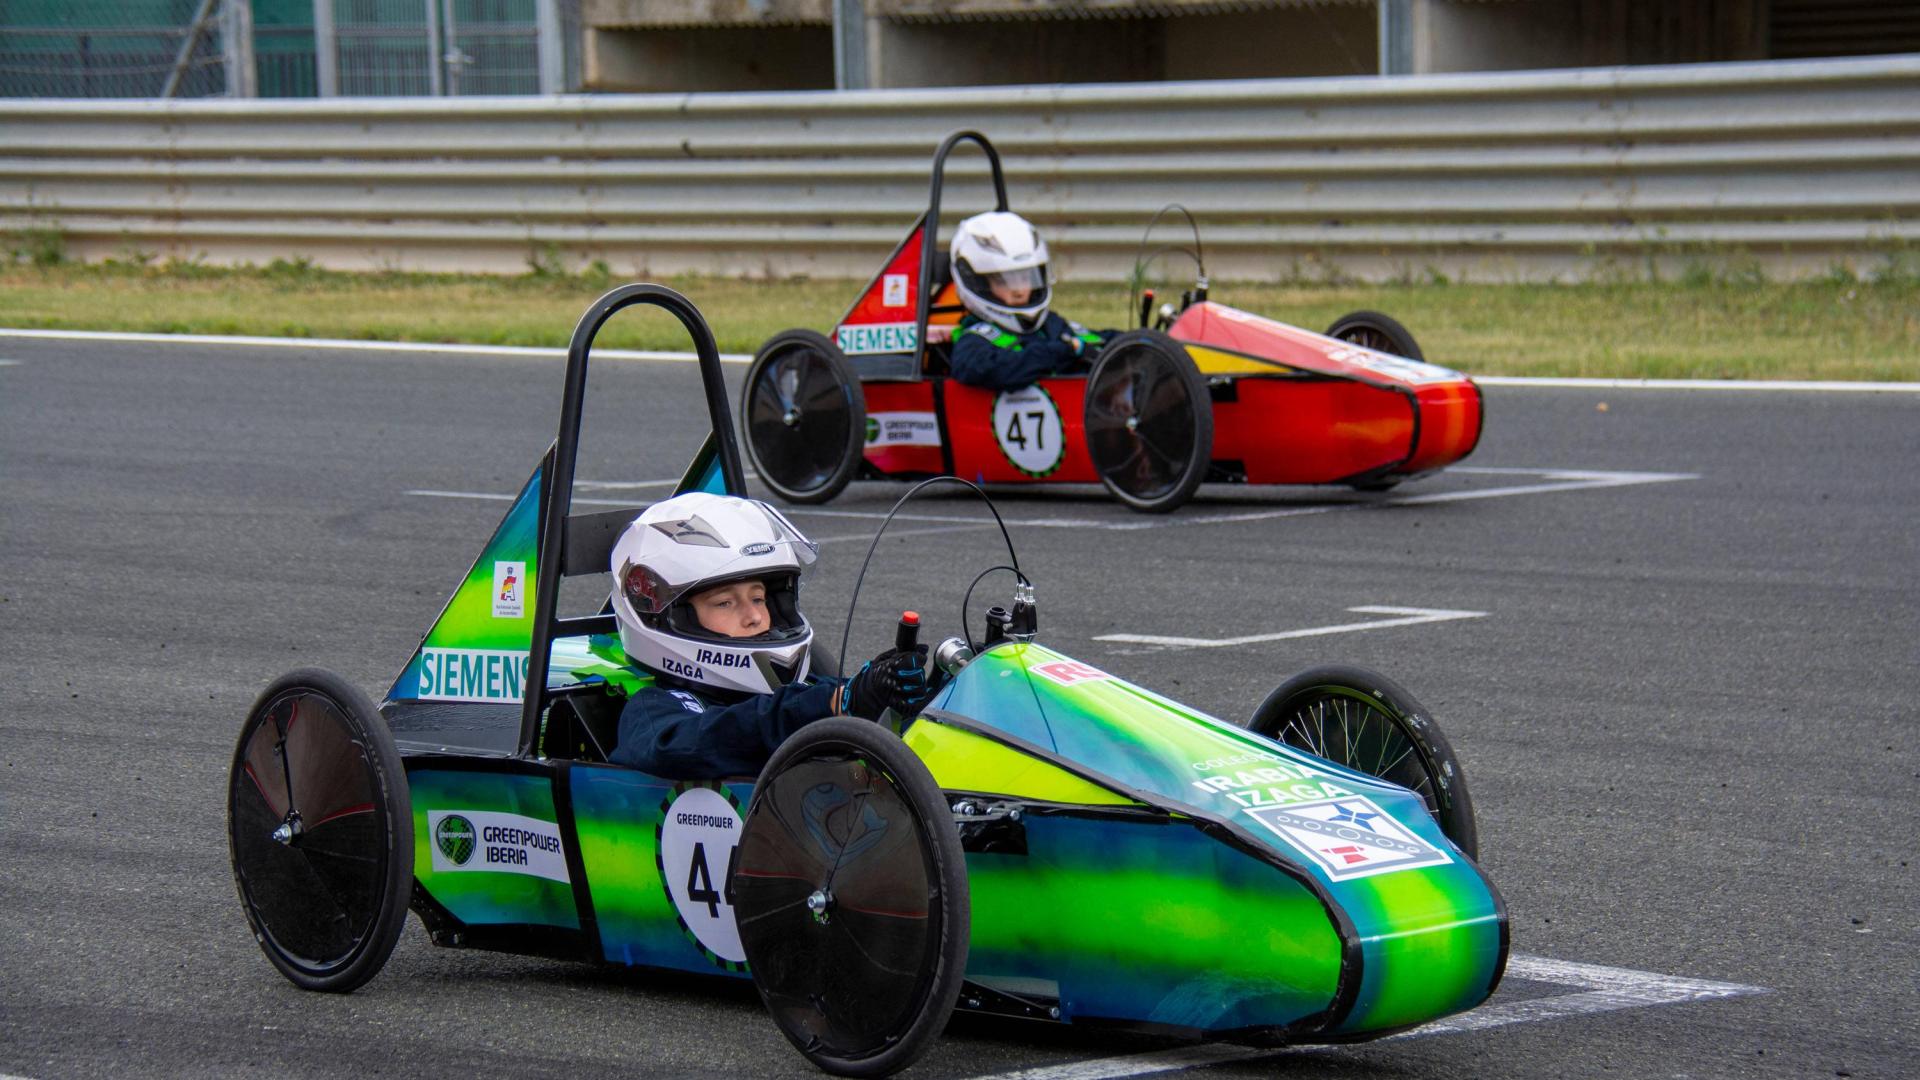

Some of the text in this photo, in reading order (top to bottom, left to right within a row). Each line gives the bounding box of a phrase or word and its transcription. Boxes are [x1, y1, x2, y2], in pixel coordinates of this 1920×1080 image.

[838, 325, 916, 351] SIEMENS
[1007, 412, 1044, 450] 47
[662, 657, 704, 680] IZAGA
[696, 648, 751, 669] IRABIA
[1192, 763, 1325, 794] IRABIA
[1225, 781, 1355, 807] IZAGA
[676, 812, 733, 829] GREENPOWER
[483, 826, 561, 854] GREENPOWER
[486, 846, 528, 866] IBERIA
